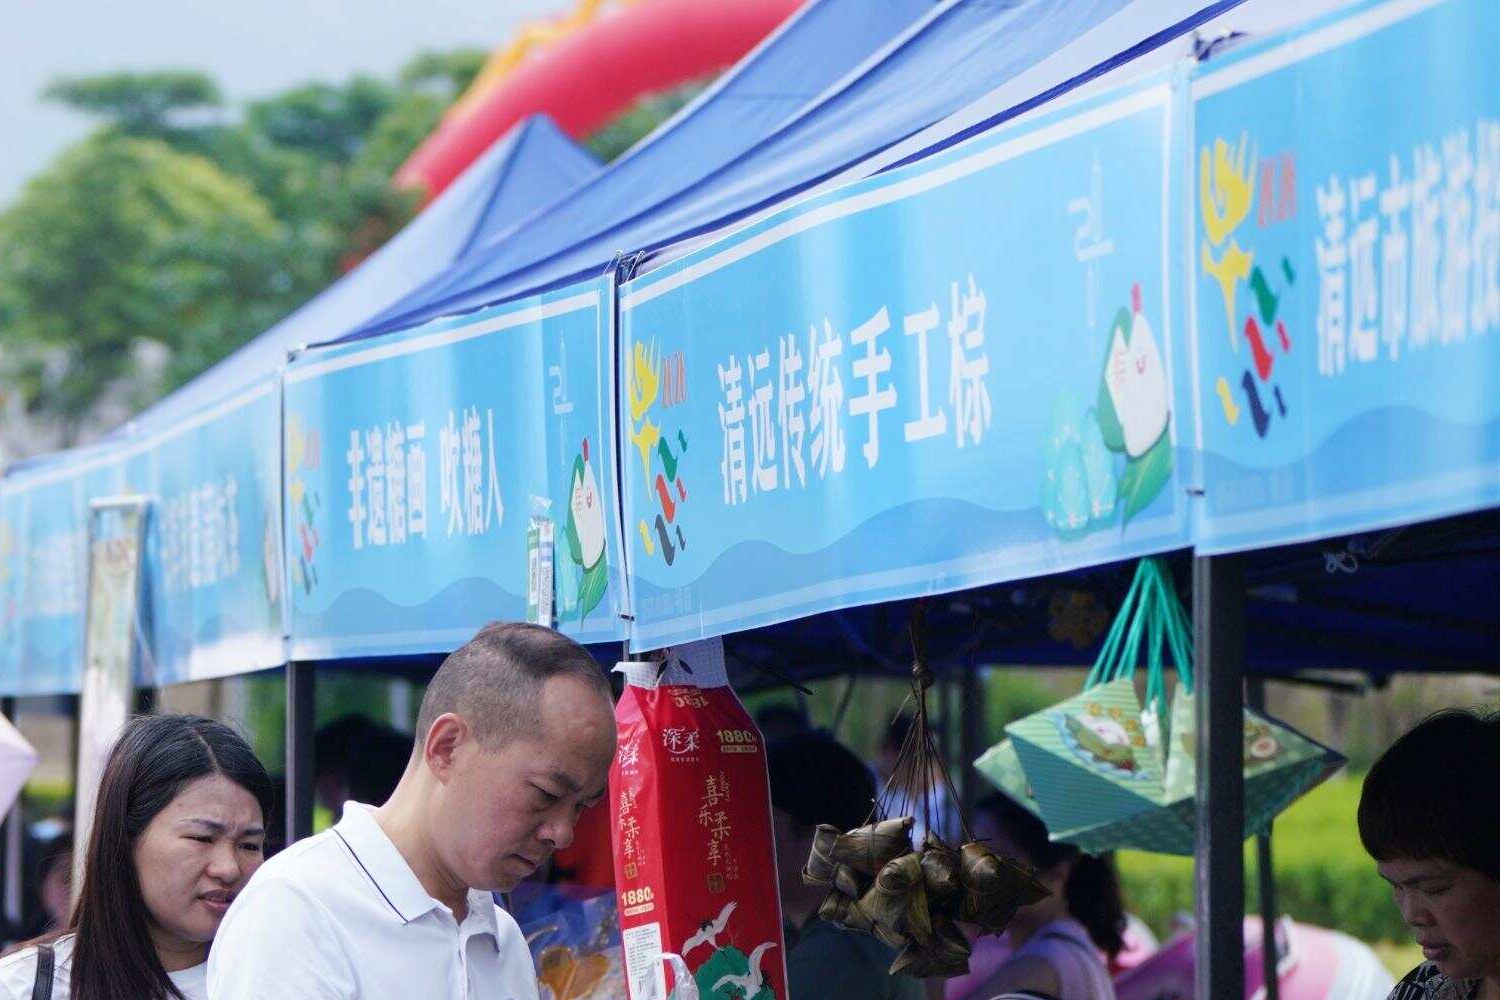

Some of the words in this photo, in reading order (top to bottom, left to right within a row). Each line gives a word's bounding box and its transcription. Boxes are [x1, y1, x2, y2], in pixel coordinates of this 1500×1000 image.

[439, 404, 504, 540] 吹糖人
[717, 271, 992, 506] 清远传统手工粽
